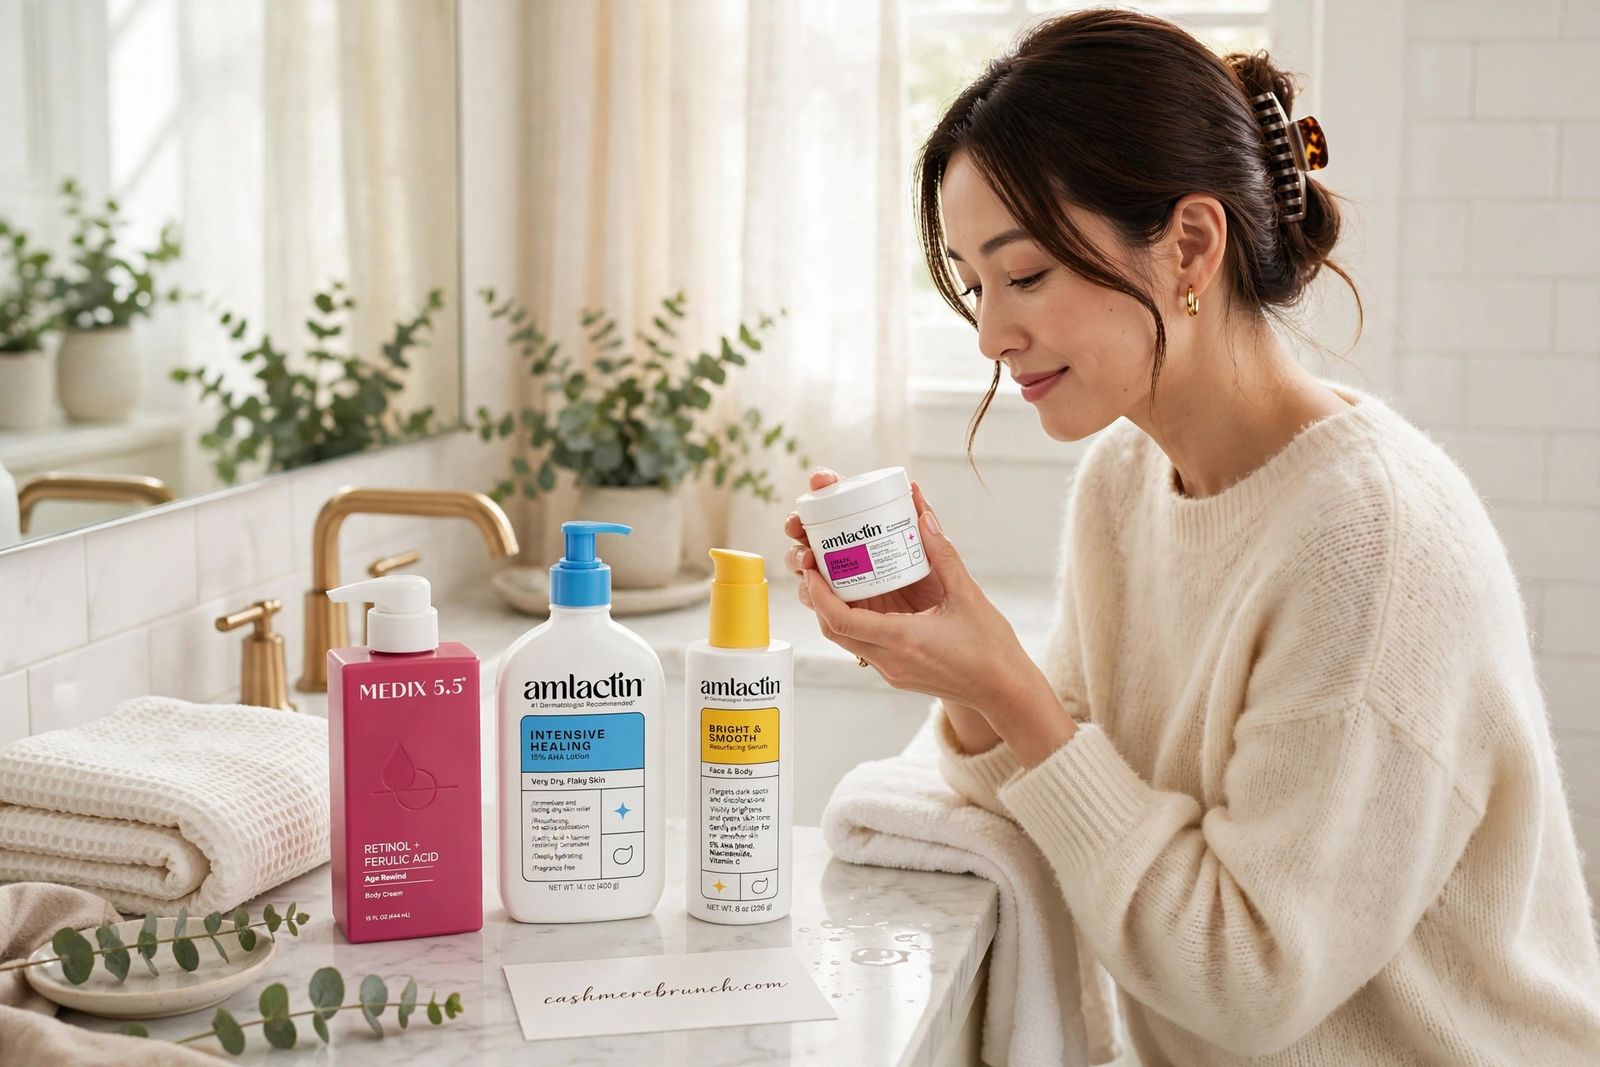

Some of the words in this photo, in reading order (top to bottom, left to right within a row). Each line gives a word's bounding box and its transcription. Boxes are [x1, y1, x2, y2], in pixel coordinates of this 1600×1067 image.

[821, 524, 882, 549] amlactin
[360, 681, 427, 700] MEDIX
[524, 672, 643, 700] amlactin
[700, 676, 780, 696] amlactin
[709, 725, 750, 733] BRIGHT
[753, 725, 762, 733] &
[530, 729, 605, 740] INTENSIVE
[709, 734, 757, 743] SMOOTH
[530, 741, 591, 751] HEALING
[709, 744, 746, 752] Resurfacing
[734, 768, 753, 776] Body
[531, 778, 548, 786] Very
[550, 778, 565, 786] Dry,
[567, 777, 587, 785] Flaky
[589, 776, 605, 784] Skin
[364, 841, 411, 854] RETINOL
[364, 854, 410, 867] FERULIC
[412, 851, 439, 863] ACID
[364, 874, 380, 883] Age
[380, 872, 407, 881] Rewind
[596, 882, 611, 890] (400
[612, 881, 620, 890] g)
[364, 891, 381, 899] Body
[706, 903, 720, 911] NET
[750, 903, 765, 912] (226
[766, 903, 773, 911] g)
[543, 977, 789, 1005] cashmerebrunch.com
